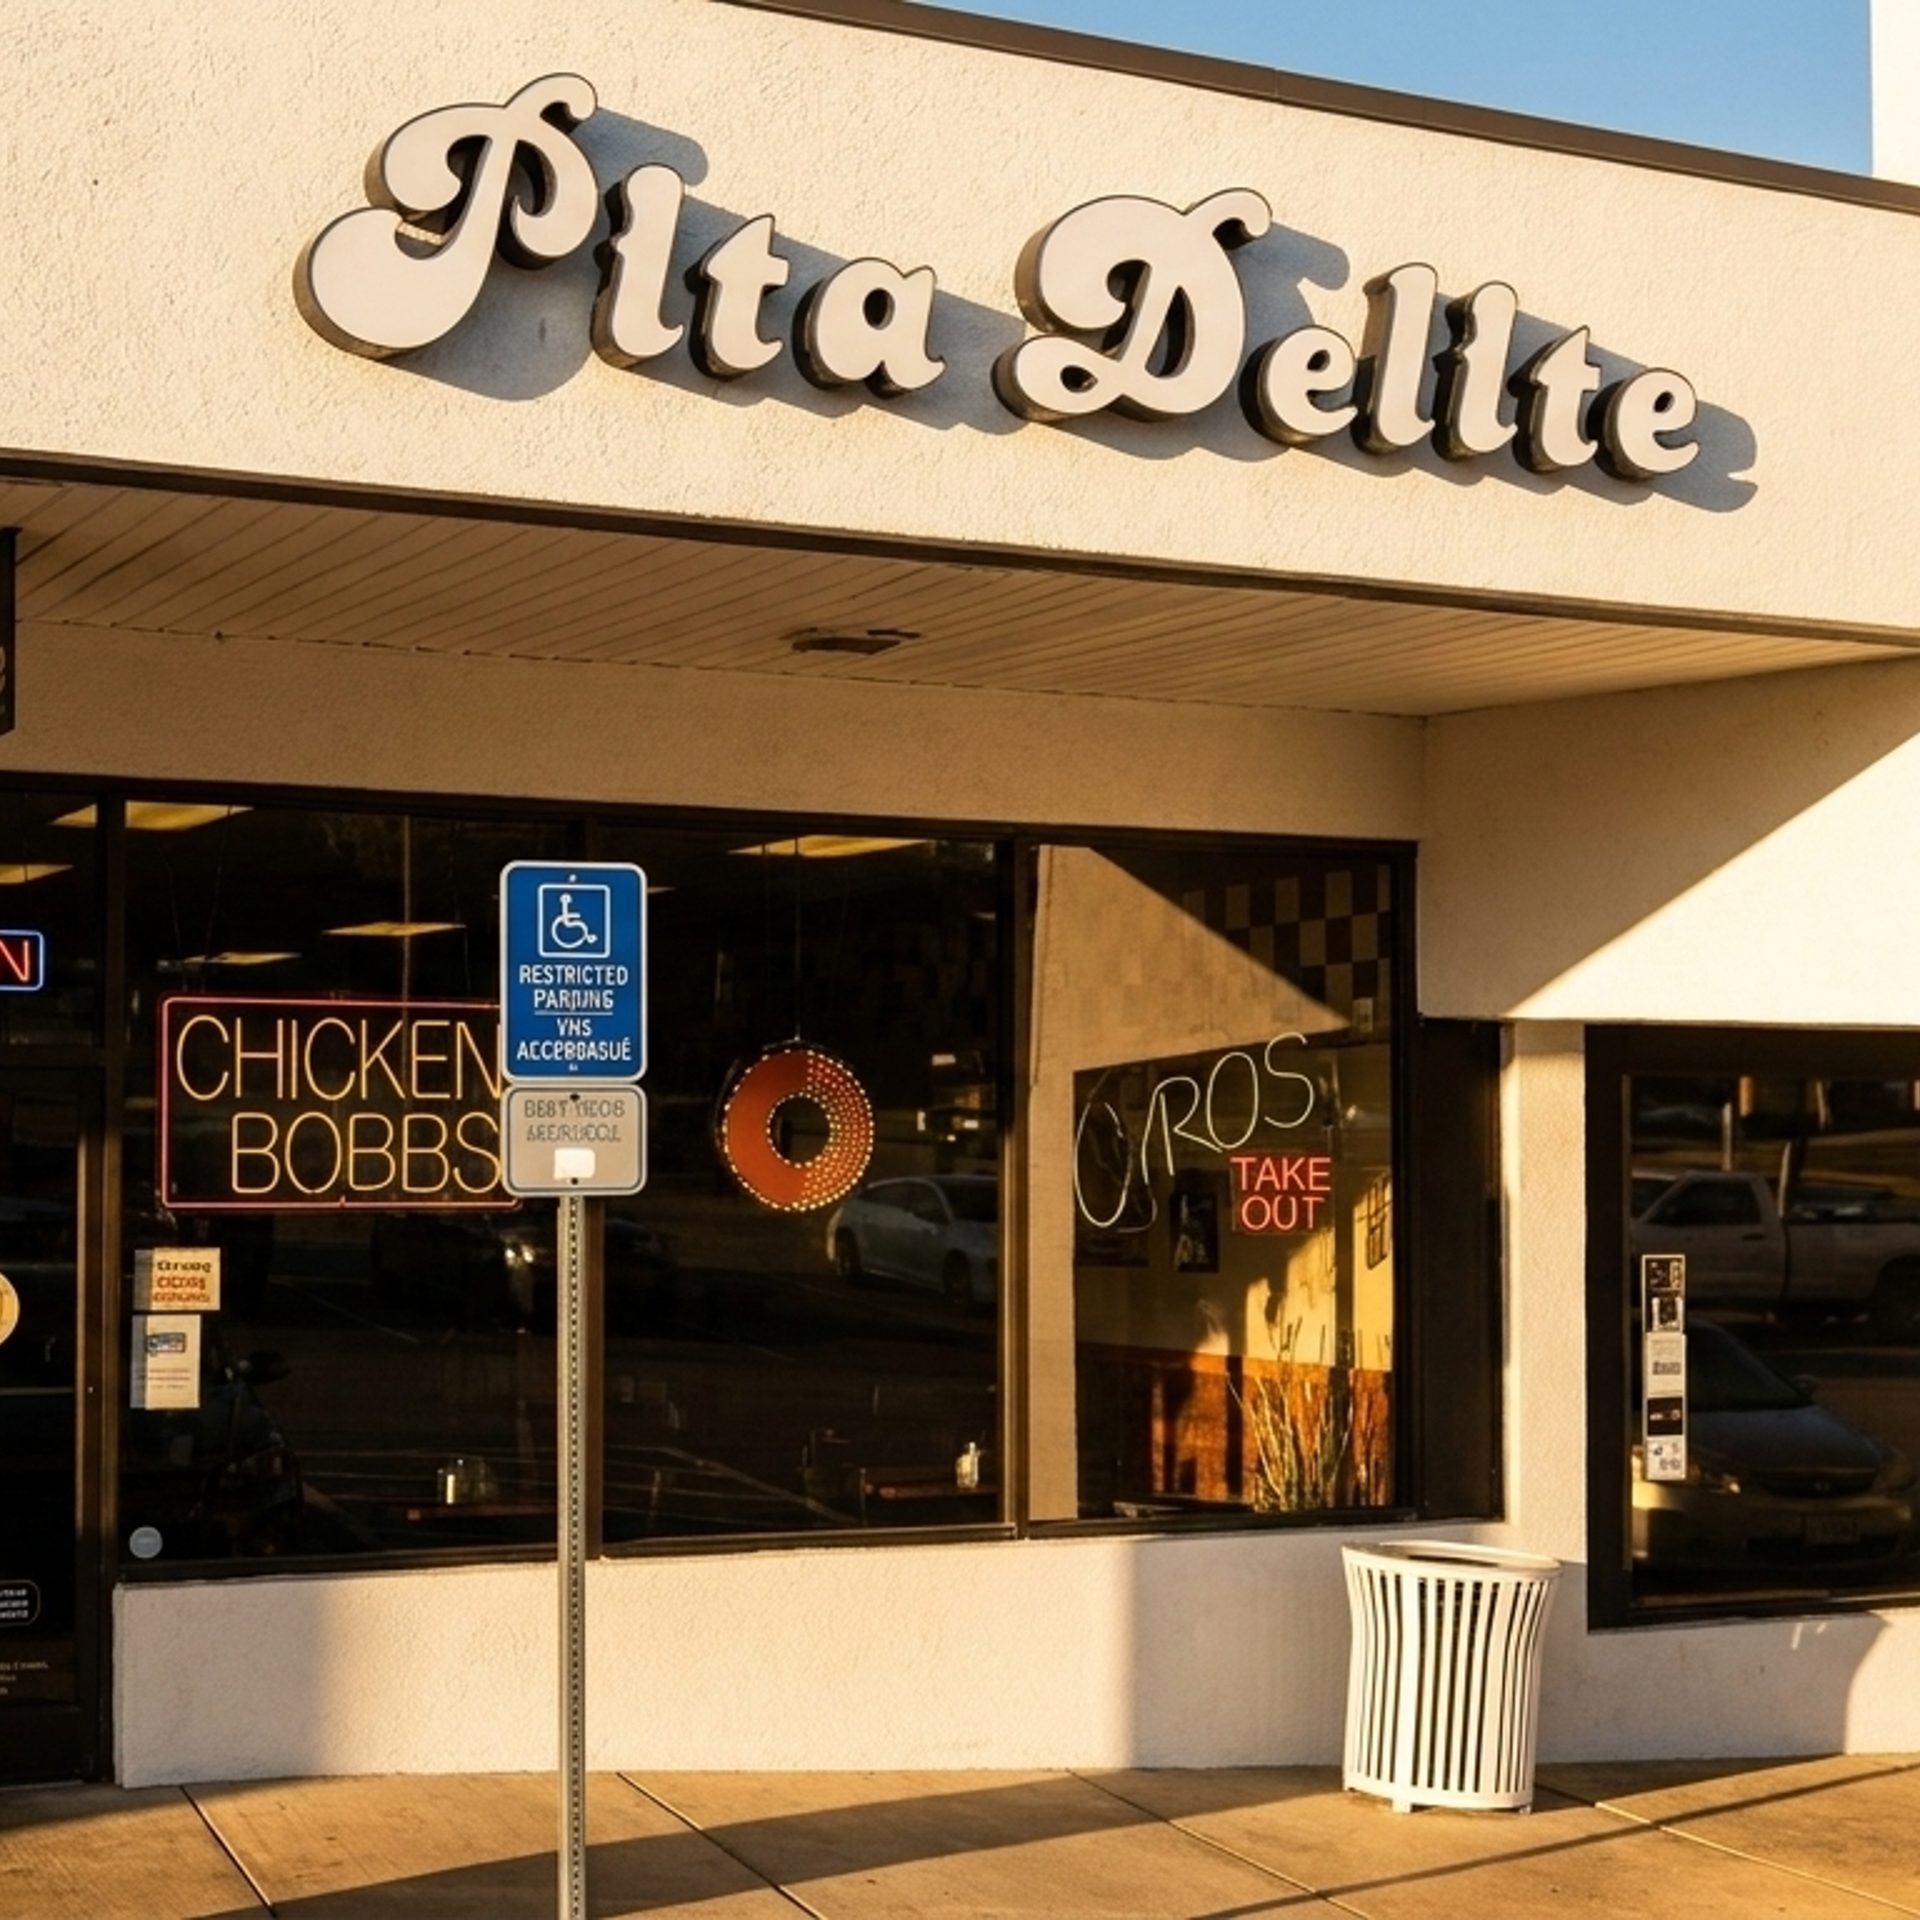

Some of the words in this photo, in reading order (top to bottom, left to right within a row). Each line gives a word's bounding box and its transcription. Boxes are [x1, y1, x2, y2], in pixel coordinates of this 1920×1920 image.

[519, 964, 629, 986] RESTRICTED
[176, 1014, 501, 1100] CHICKEN
[231, 1111, 501, 1194] BOBBS
[1230, 1156, 1332, 1192] TAKE
[1240, 1195, 1326, 1231] OUT
